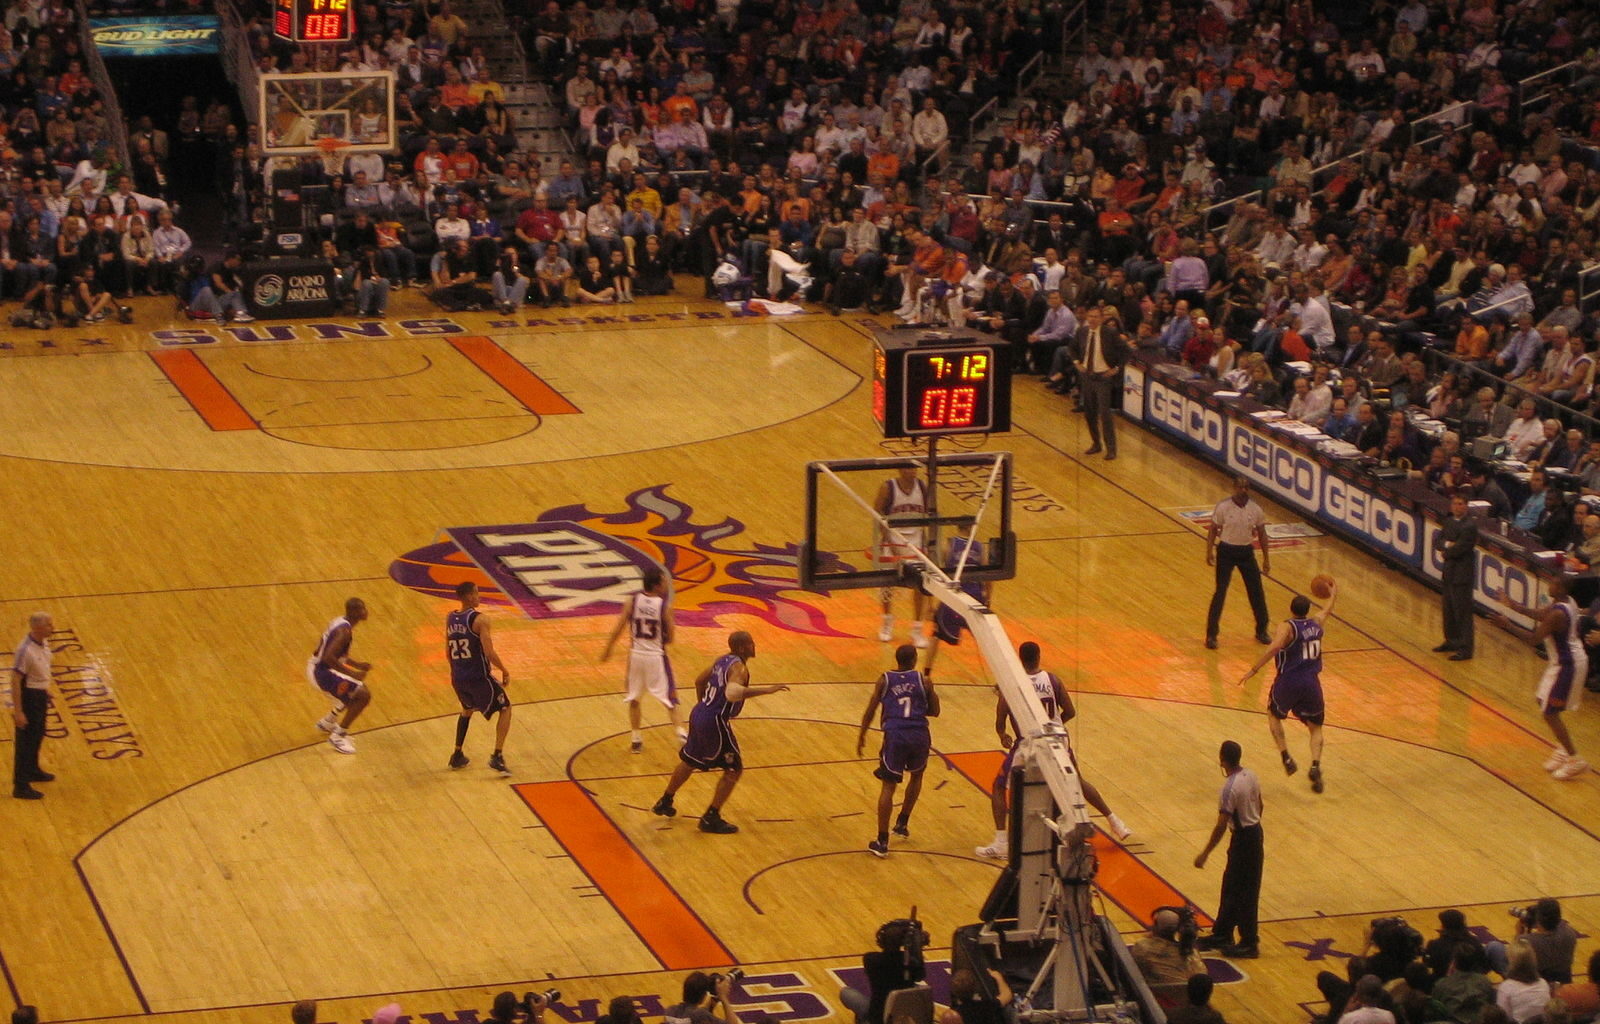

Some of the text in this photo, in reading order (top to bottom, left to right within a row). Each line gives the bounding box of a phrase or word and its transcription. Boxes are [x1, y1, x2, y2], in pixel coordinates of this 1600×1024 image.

[93, 29, 217, 41] BUD LIGHT
[304, 13, 342, 38] 08
[150, 318, 467, 346] SUNS
[930, 355, 988, 379] 7:12
[920, 387, 975, 426] 08
[1149, 380, 1224, 451] GEICO
[1234, 424, 1315, 501] GEICO
[1324, 474, 1416, 556] GEICO
[475, 528, 650, 612] PHX
[634, 618, 658, 639] 13
[448, 638, 472, 660] 23
[1302, 639, 1321, 660] 10
[50, 657, 144, 760] AIRWAYS
[898, 697, 912, 718] 7
